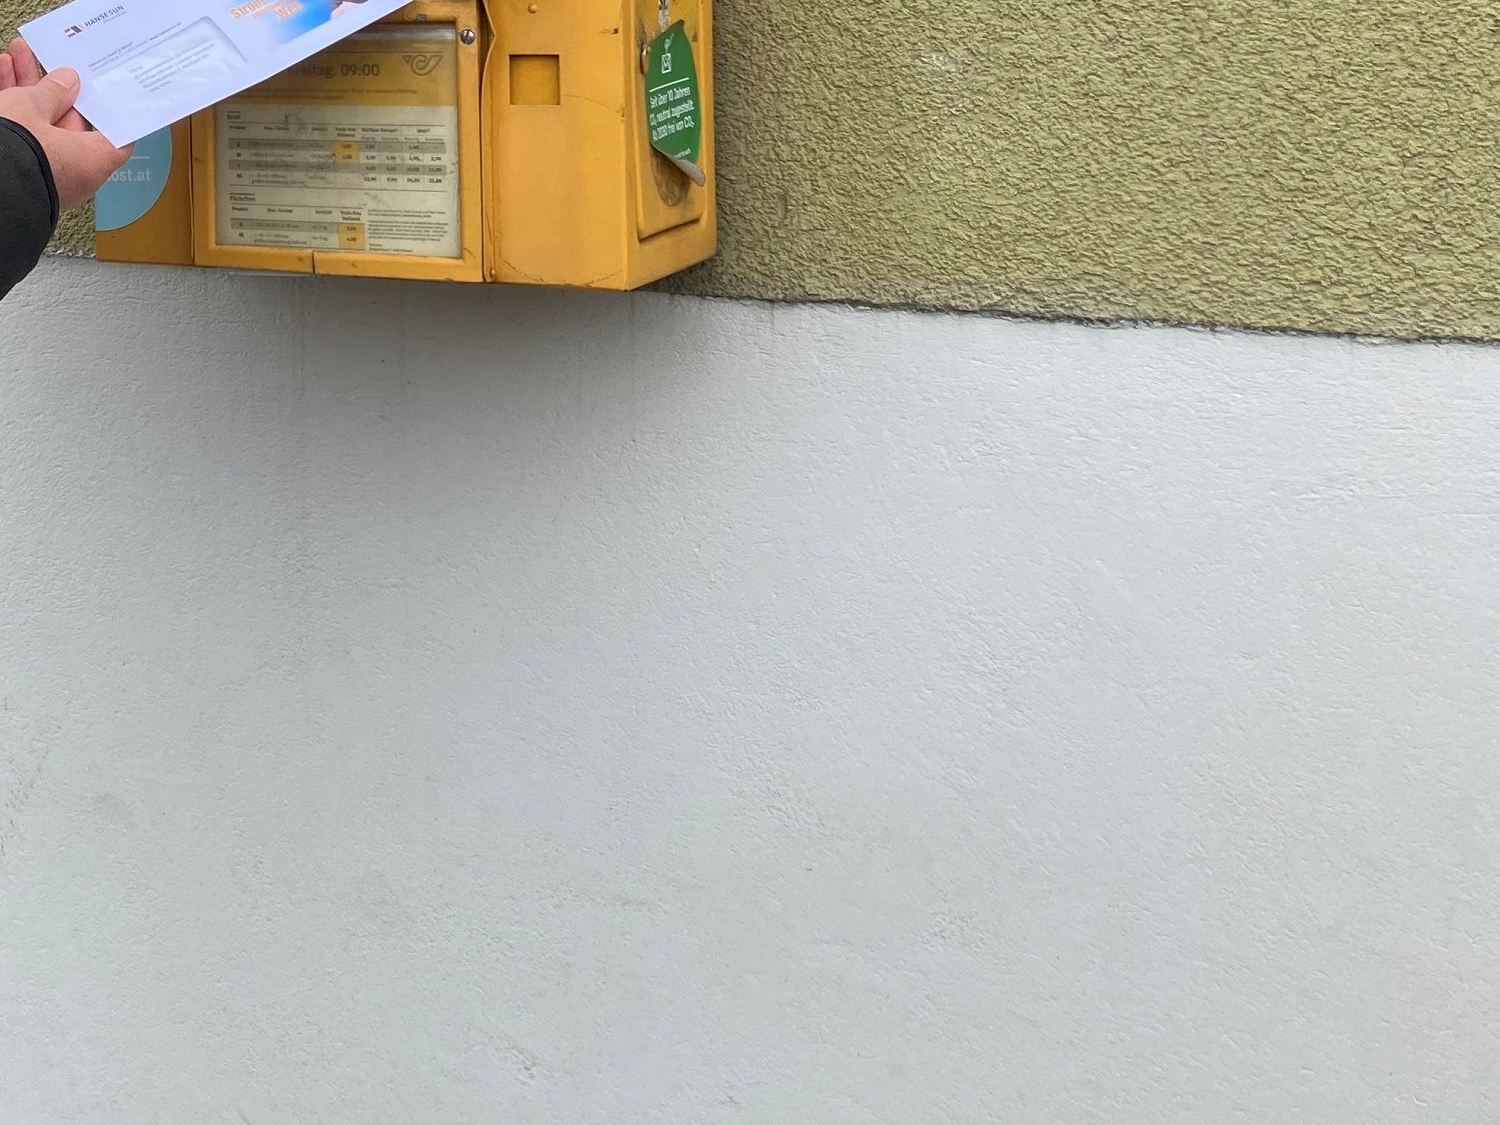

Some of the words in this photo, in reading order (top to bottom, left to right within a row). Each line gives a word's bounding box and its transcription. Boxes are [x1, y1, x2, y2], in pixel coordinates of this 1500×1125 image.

[85, 5, 124, 27] HANSESUN
[341, 63, 380, 76] 09:00
[110, 168, 152, 181] ost.at
